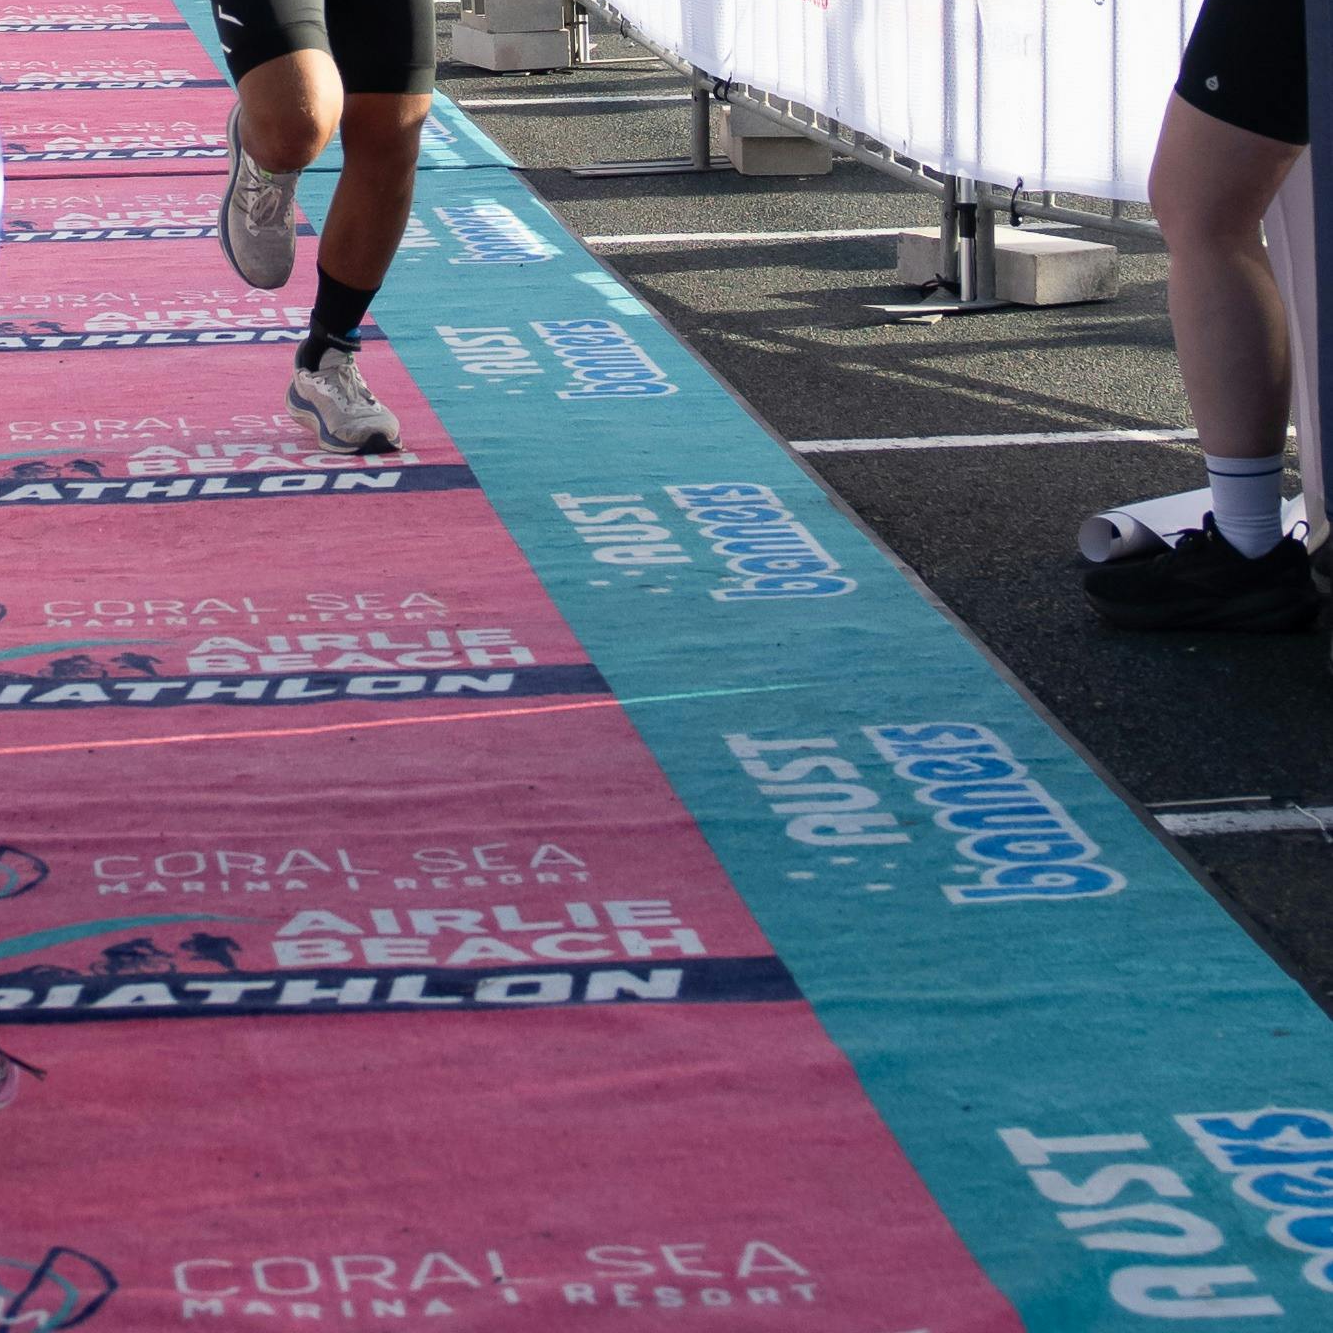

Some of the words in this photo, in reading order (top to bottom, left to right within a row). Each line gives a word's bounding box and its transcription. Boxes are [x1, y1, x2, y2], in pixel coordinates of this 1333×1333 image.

[175, 287, 279, 301] SEA
[433, 325, 546, 375] AUST
[528, 318, 680, 400] banners
[7, 415, 207, 434] CORAL
[550, 492, 693, 566] AUST
[661, 481, 860, 604] banners
[42, 596, 277, 619] CORAL
[305, 592, 447, 611] SEA
[45, 615, 220, 630] MARINA
[287, 609, 450, 623] RESORT
[185, 644, 536, 677] BEACH
[189, 628, 520, 655] AIRLIE
[724, 732, 914, 848] AUST
[861, 722, 1129, 906] banners
[92, 847, 379, 882] CORAL
[412, 842, 588, 872] SEA
[97, 877, 309, 895] MARINA
[393, 870, 592, 891] RESORT
[271, 898, 684, 938] AIRLIE
[270, 928, 708, 968] BEACH
[996, 1125, 1285, 1319] AUST
[170, 1249, 531, 1298] CORAL
[585, 1238, 810, 1281] SEA
[181, 1296, 453, 1319] MARINA
[562, 1280, 819, 1308] RESORT
